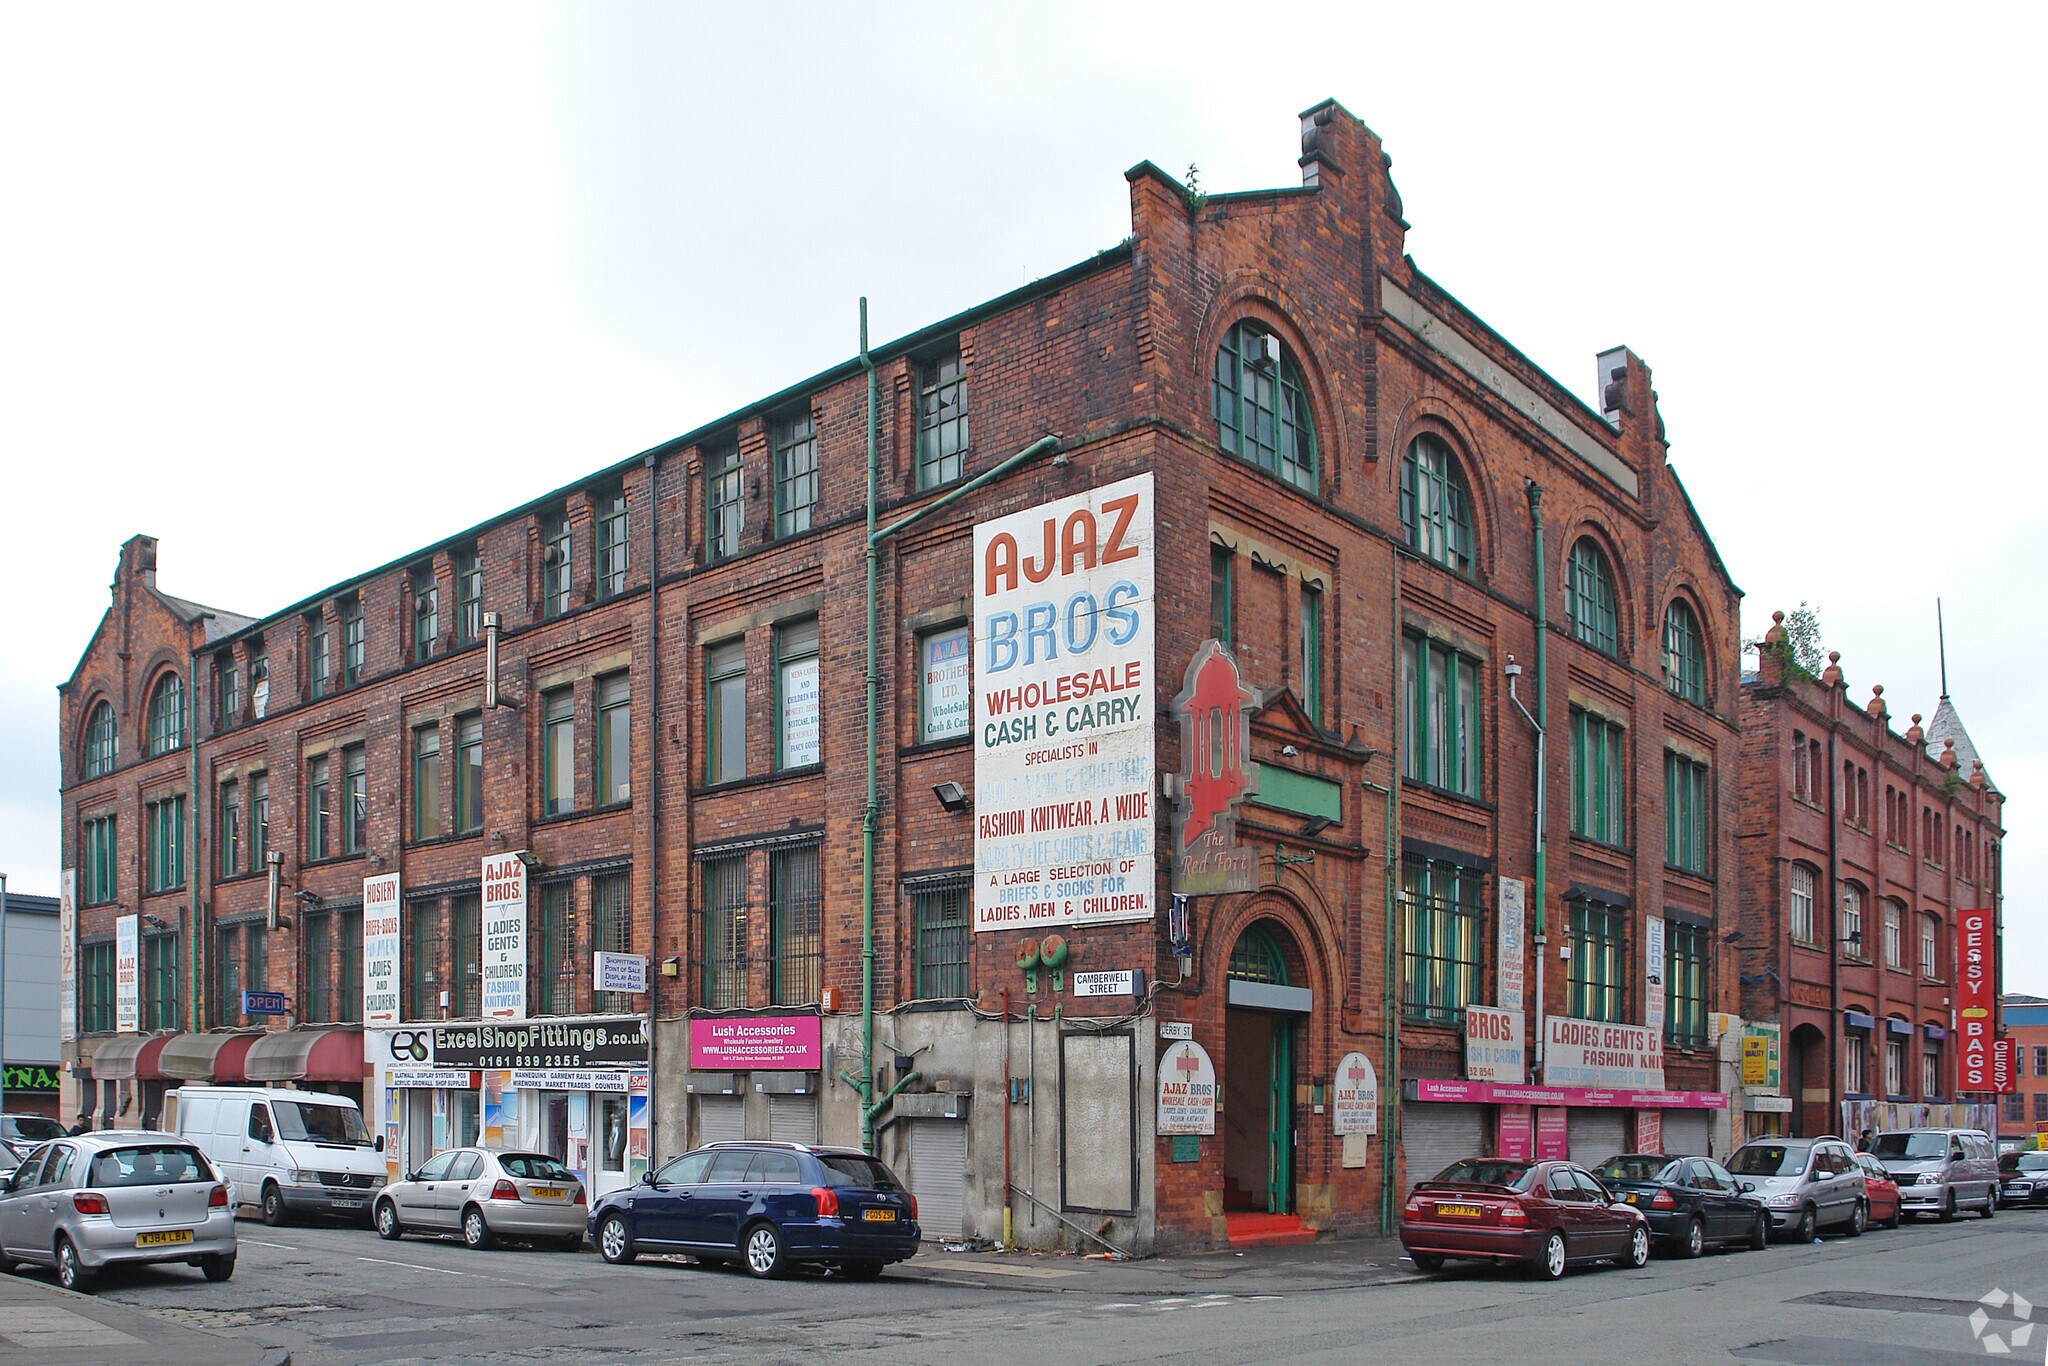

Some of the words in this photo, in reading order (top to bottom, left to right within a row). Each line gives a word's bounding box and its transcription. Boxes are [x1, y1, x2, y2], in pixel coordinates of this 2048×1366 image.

[985, 493, 1139, 597] AJAZ
[985, 580, 1140, 675] BROS
[932, 638, 968, 662] AJAZ
[800, 680, 810, 689] AND
[986, 661, 1141, 717] WHOLESALE
[928, 721, 944, 734] Cash
[984, 714, 1037, 748] CASH
[1045, 711, 1059, 737] &
[1066, 694, 1141, 733] CARRY.
[1025, 743, 1084, 766] SPECIALISTS
[1088, 741, 1098, 756] IN
[979, 809, 1025, 839] FASHION
[1100, 797, 1109, 823] A
[1115, 792, 1148, 822] WIDE
[1054, 834, 1093, 864] SHIRTS
[1108, 827, 1148, 857] JEANS
[1203, 830, 1224, 847] The
[485, 859, 522, 883] AJAZ
[989, 875, 998, 887] A
[1004, 870, 1040, 886] LARGE
[1050, 861, 1111, 881] SELECTION
[1119, 860, 1135, 873] OF
[1181, 851, 1211, 880] Red
[366, 880, 397, 904] HOSIERY
[1000, 886, 1038, 904] BRIEFS
[1044, 884, 1051, 900] &
[1057, 880, 1094, 899] SOCKS
[1101, 876, 1125, 893] FOR
[1065, 900, 1073, 916] &
[487, 919, 521, 936] LADIES
[488, 935, 519, 951] GENTS
[119, 957, 135, 970] AJAZ
[500, 953, 508, 962] &
[1965, 916, 1983, 995] GESSY
[368, 960, 392, 977] LADIES
[484, 963, 523, 980] CHILDRENS
[376, 981, 387, 991] AND
[1077, 973, 1129, 984] CAMBERWELL
[486, 980, 520, 994] FASHION
[1089, 983, 1119, 994] STREET
[247, 996, 280, 1009] OPEN
[484, 994, 521, 1008] KNITWEAR
[713, 1025, 734, 1036] Lush
[737, 1024, 795, 1036] Accessories
[1162, 1024, 1181, 1035] DERBY
[703, 1045, 807, 1055] WWW.LUSHACCESSORIES.CO.UK
[1966, 1022, 1984, 1085] BAGS
[479, 1055, 510, 1067] 0161
[515, 1055, 540, 1067] 839
[545, 1055, 580, 1066] 2355
[1583, 1050, 1634, 1067] FASHION
[1993, 1040, 2009, 1092] GESSY
[514, 1071, 547, 1079] MANNEQUINS
[550, 1072, 575, 1080] GARMENT
[595, 1073, 621, 1081] HANGERS
[1163, 1083, 1187, 1094] AJAZ
[1190, 1084, 1212, 1095] BROS
[1338, 1090, 1355, 1100] AJAZ
[1358, 1090, 1375, 1100] BROS
[1427, 1084, 1439, 1092] Lush
[1440, 1084, 1468, 1093] Accessories
[866, 1209, 882, 1219] FG05
[883, 1210, 894, 1220] ZSK
[1440, 1205, 1461, 1214] P397
[1463, 1206, 1480, 1214] XFW
[169, 1231, 187, 1242] LBA
